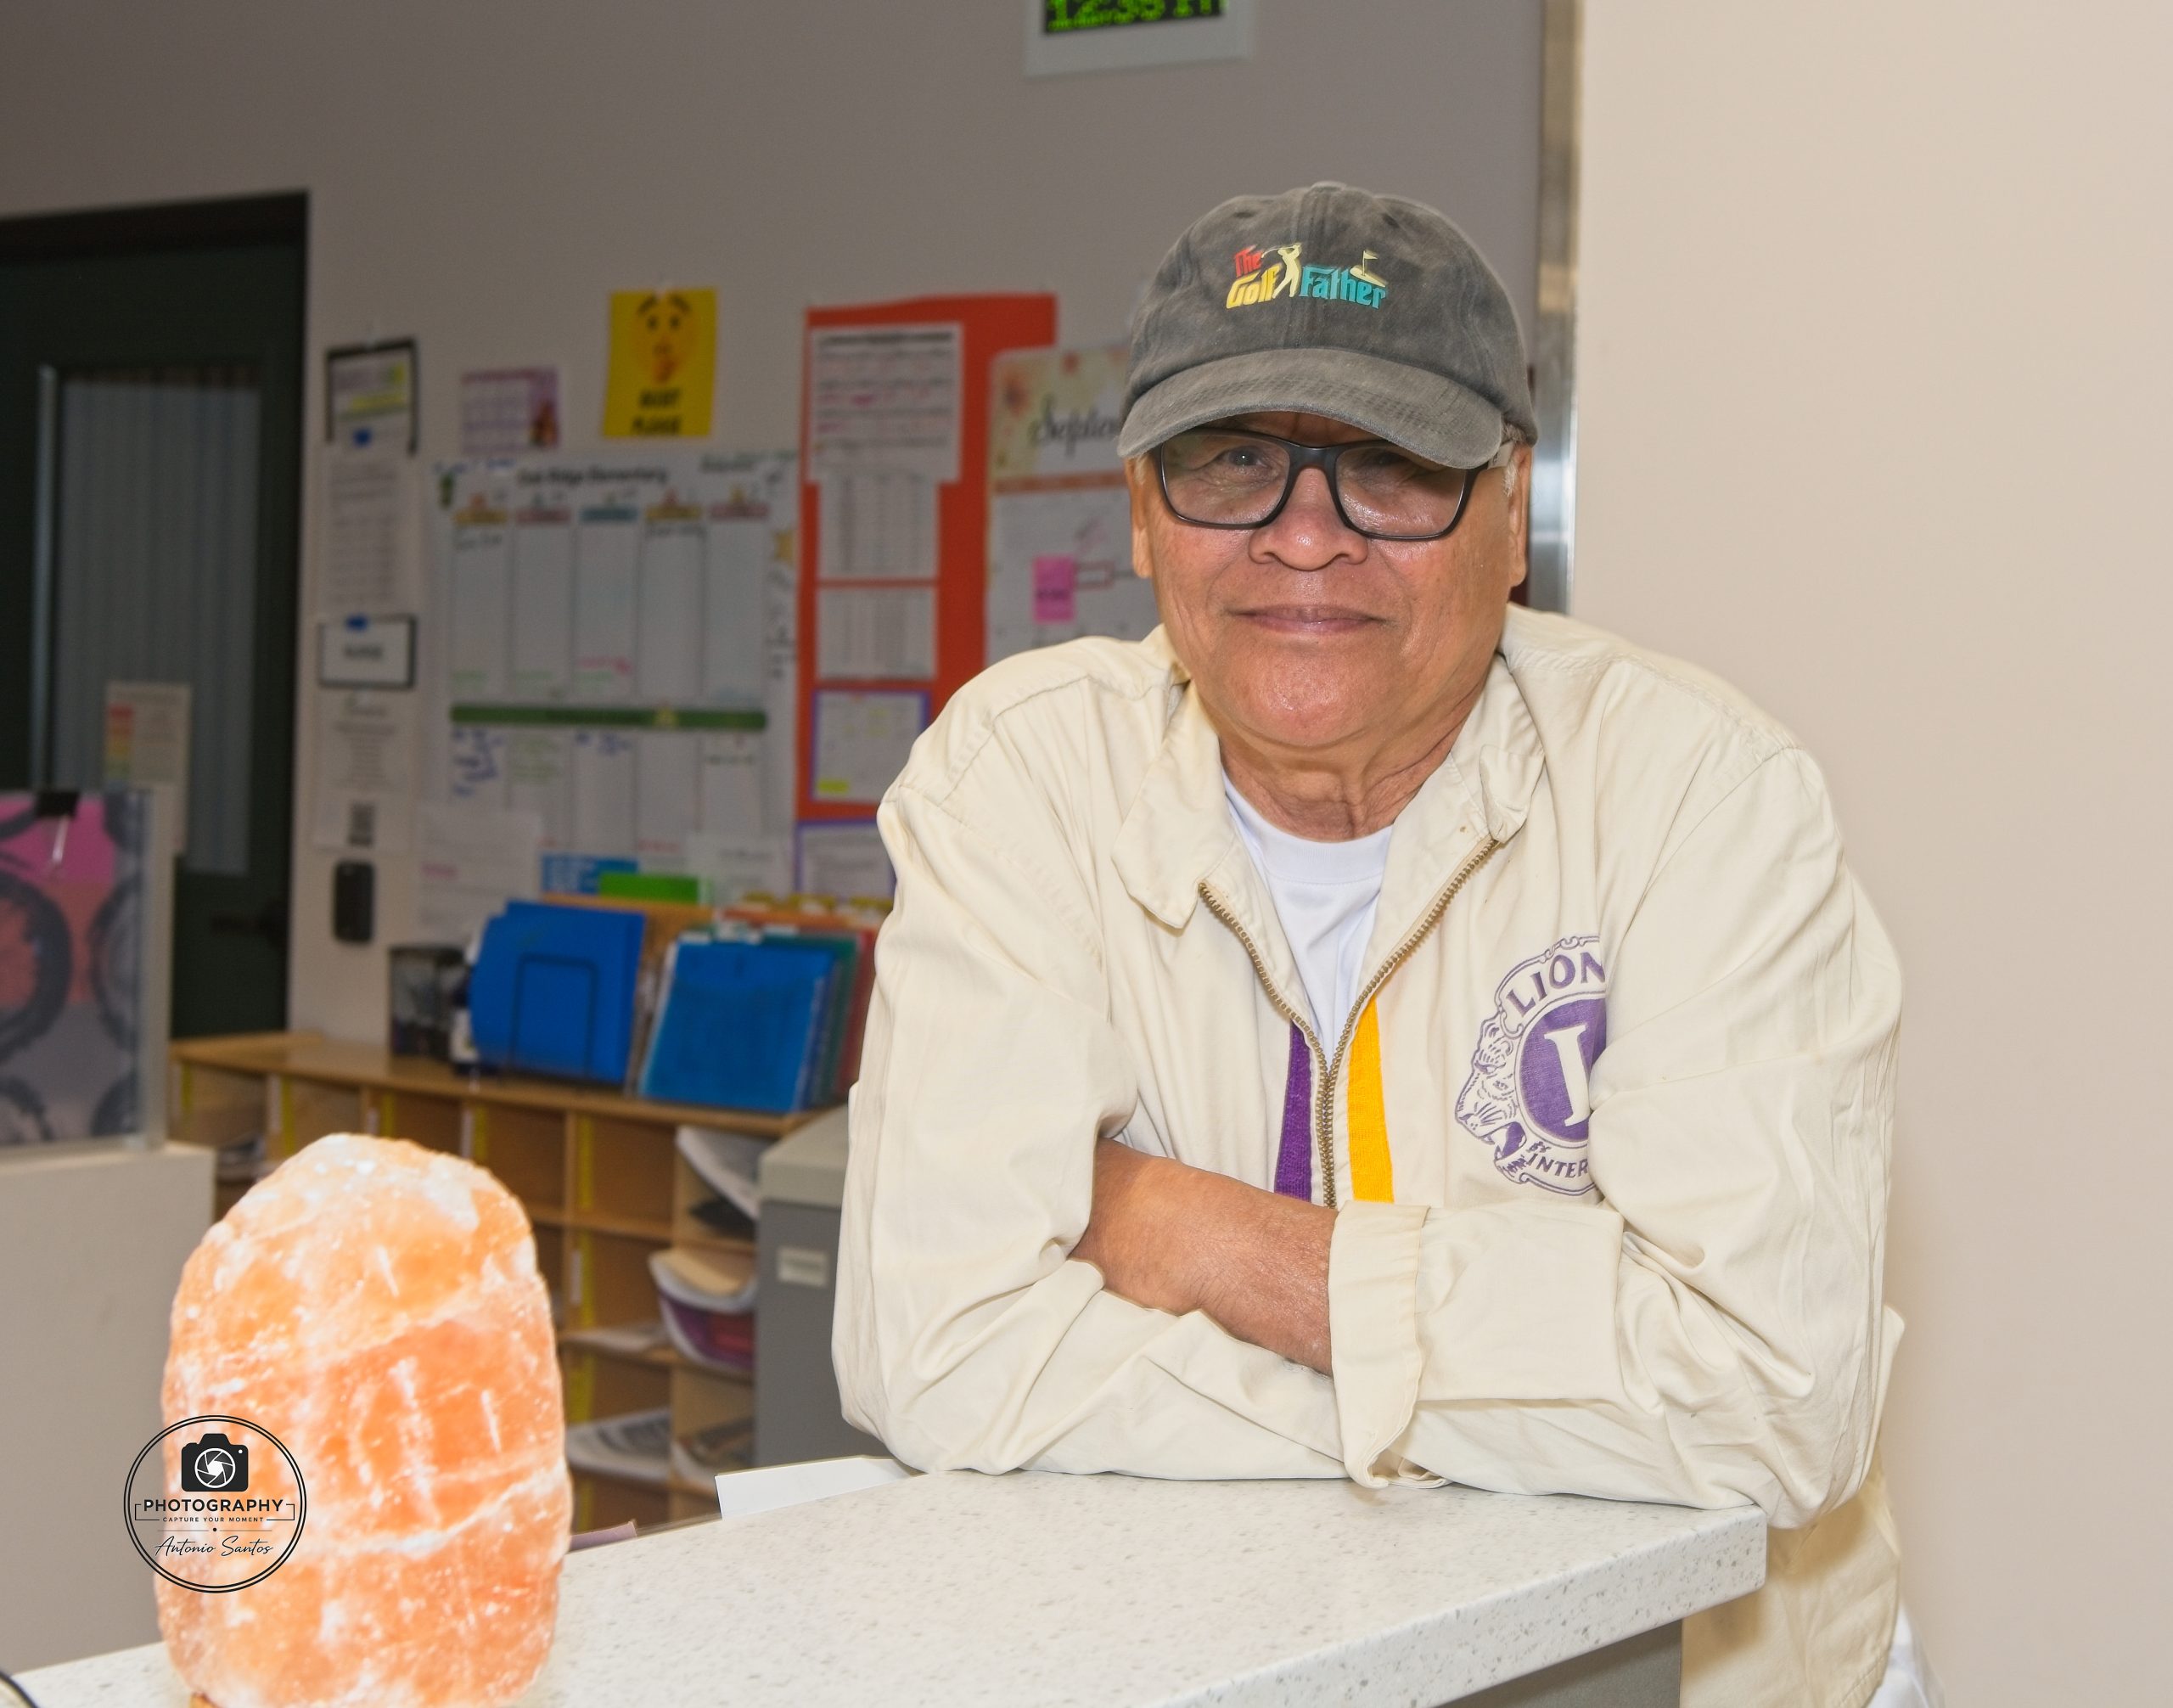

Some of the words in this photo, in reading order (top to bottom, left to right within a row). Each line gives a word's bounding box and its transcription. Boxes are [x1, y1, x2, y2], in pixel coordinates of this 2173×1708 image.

[1234, 244, 1263, 278] The
[1227, 263, 1282, 308] Golf
[1299, 264, 1386, 309] Father
